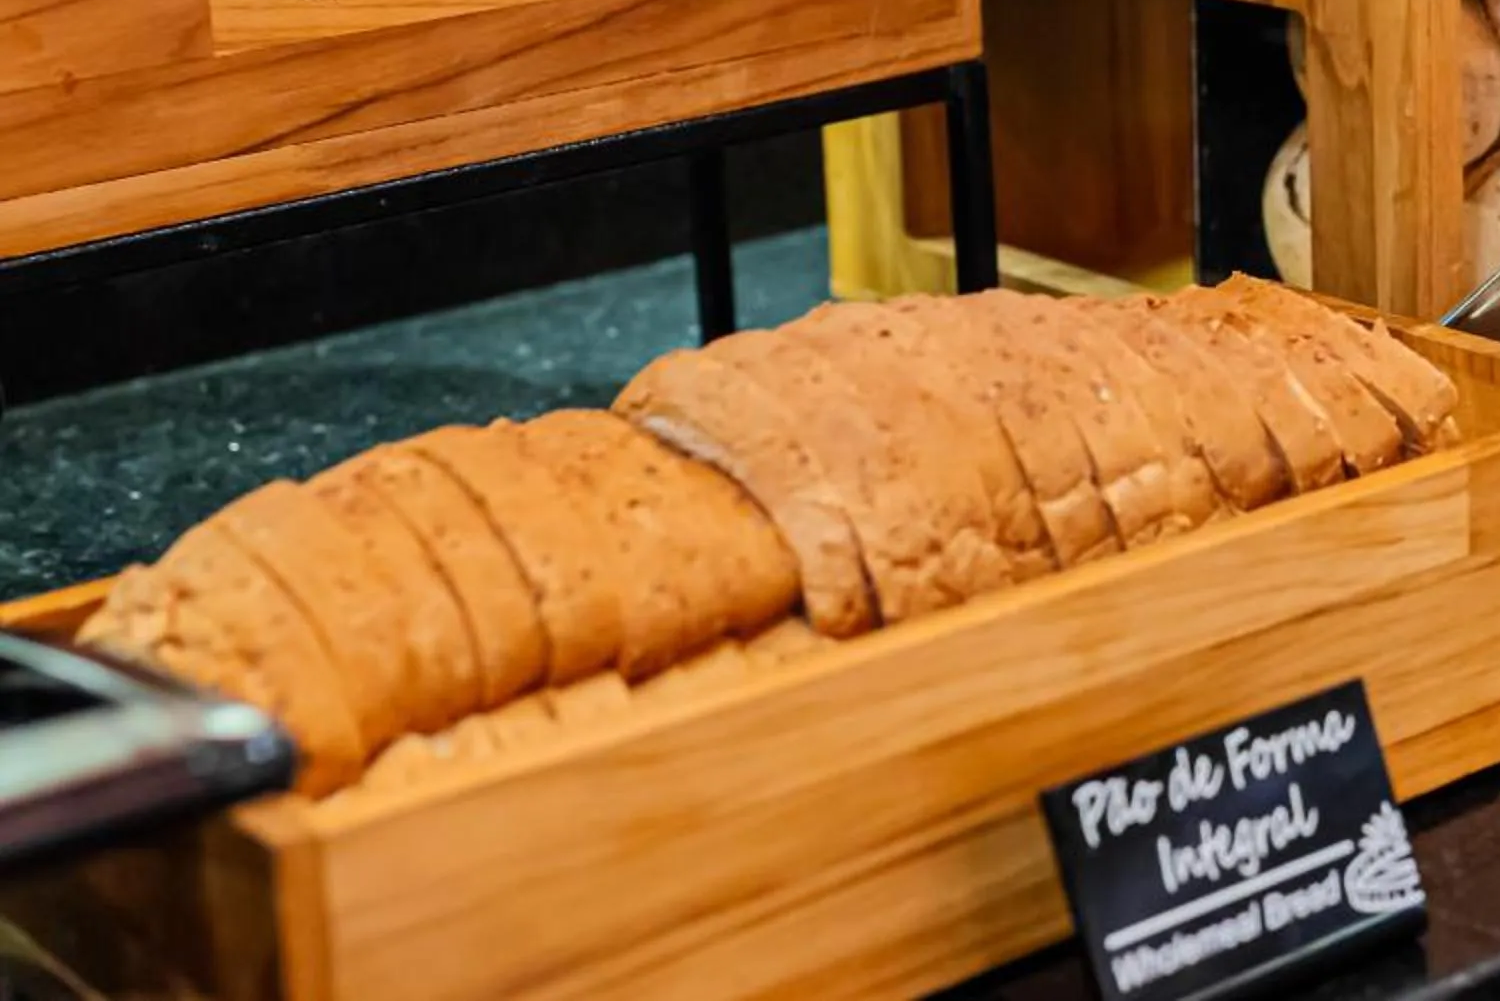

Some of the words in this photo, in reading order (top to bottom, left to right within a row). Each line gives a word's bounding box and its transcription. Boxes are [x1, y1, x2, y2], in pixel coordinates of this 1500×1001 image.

[1167, 746, 1225, 812] de
[1223, 709, 1356, 791] Forma
[1156, 782, 1320, 894] Integral
